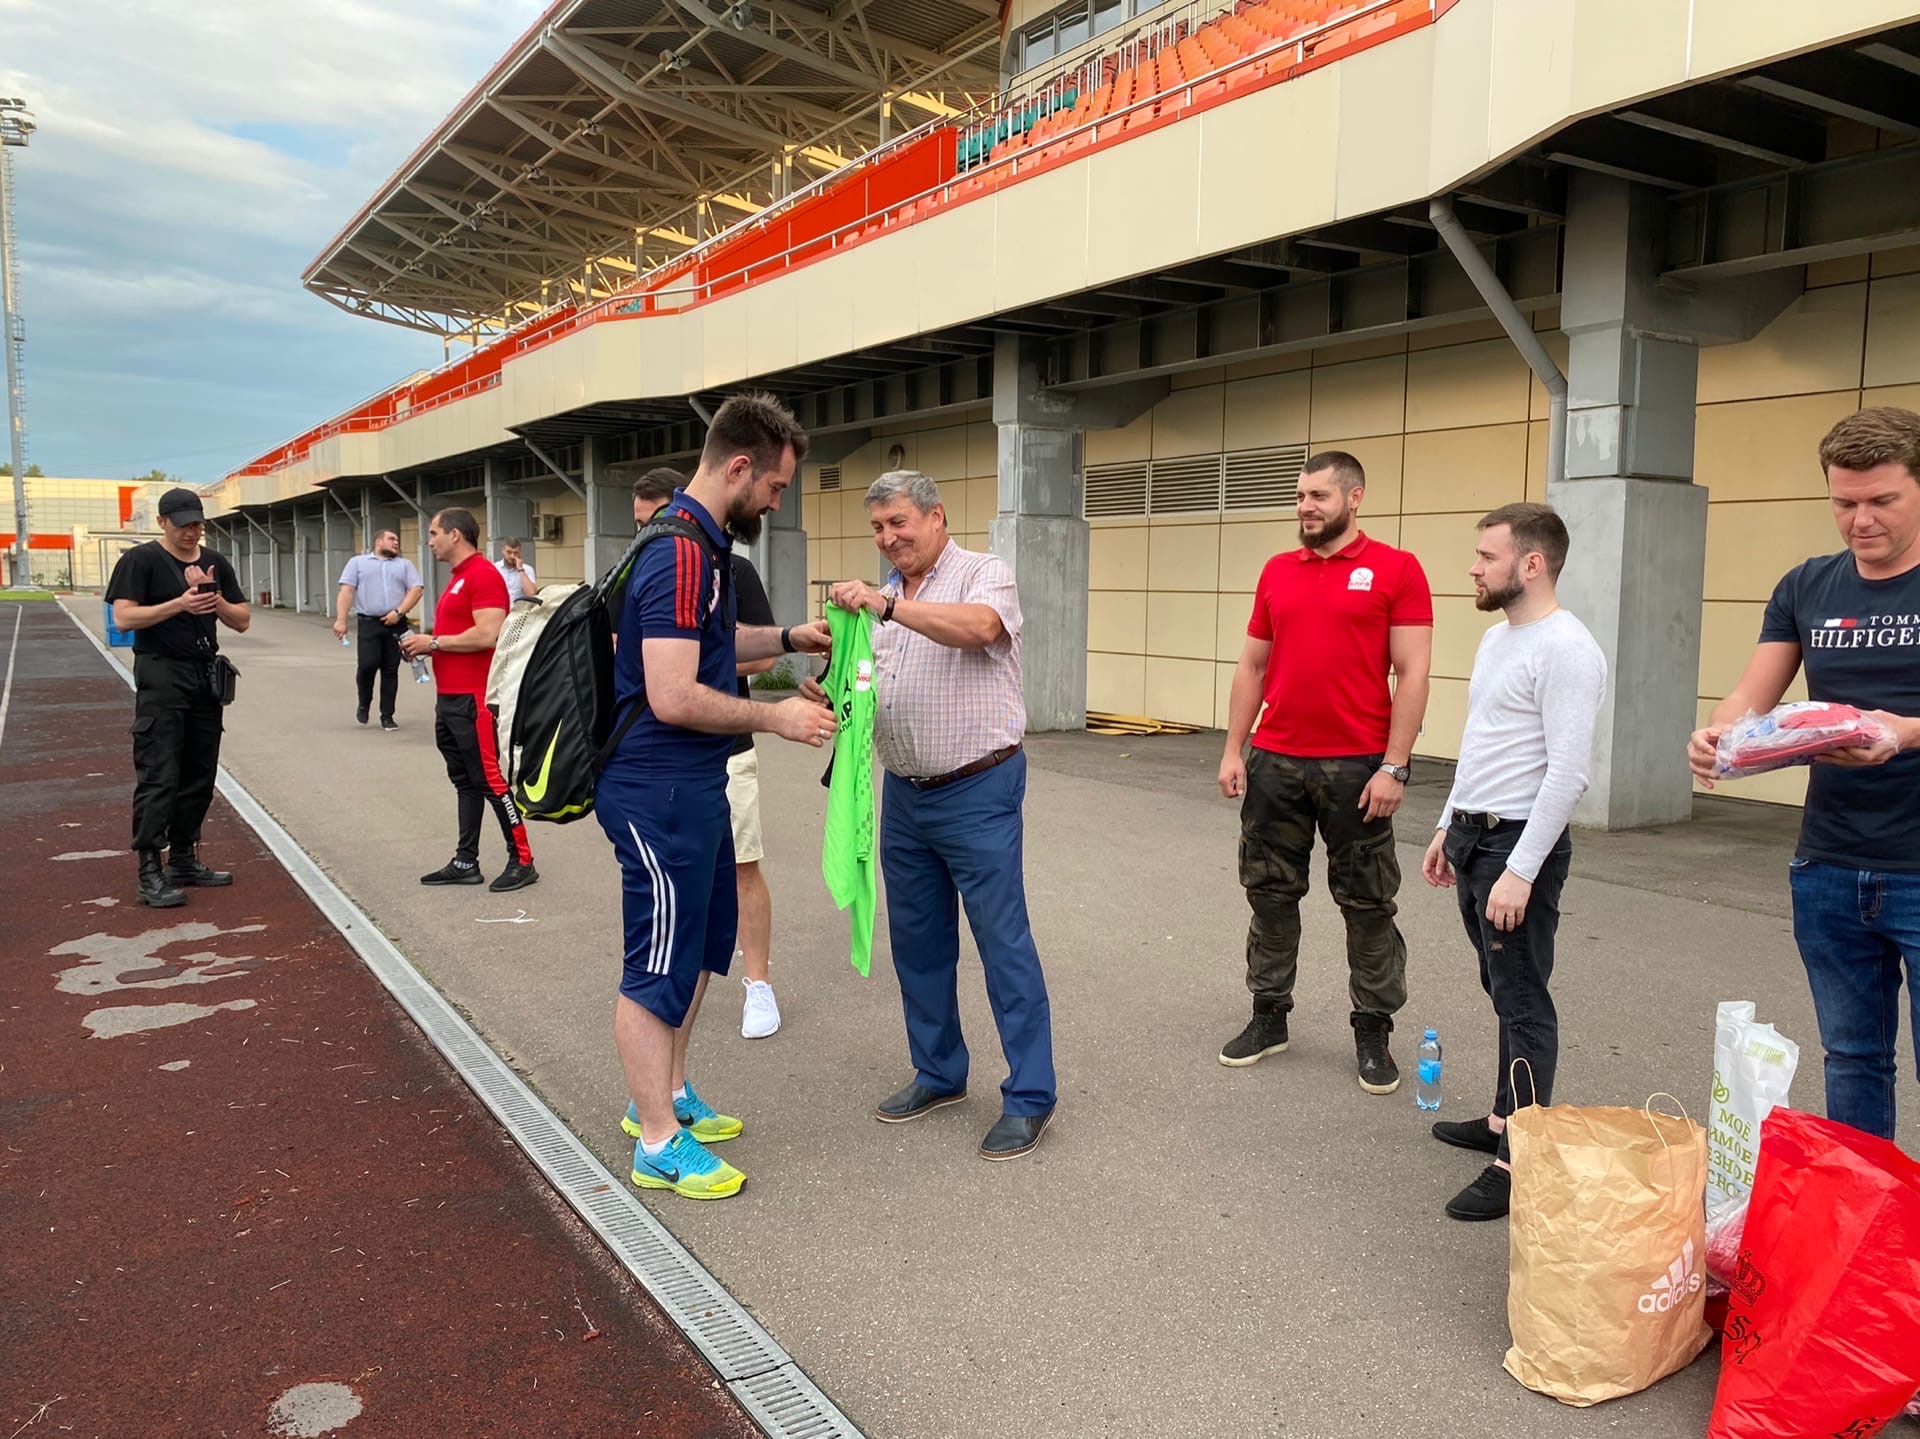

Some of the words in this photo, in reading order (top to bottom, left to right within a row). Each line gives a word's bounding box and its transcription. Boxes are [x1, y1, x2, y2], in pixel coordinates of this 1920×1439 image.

[1810, 627, 1920, 648] HILFIGE
[1718, 1108, 1752, 1142] МОЁ
[1706, 1168, 1743, 1198] СНО
